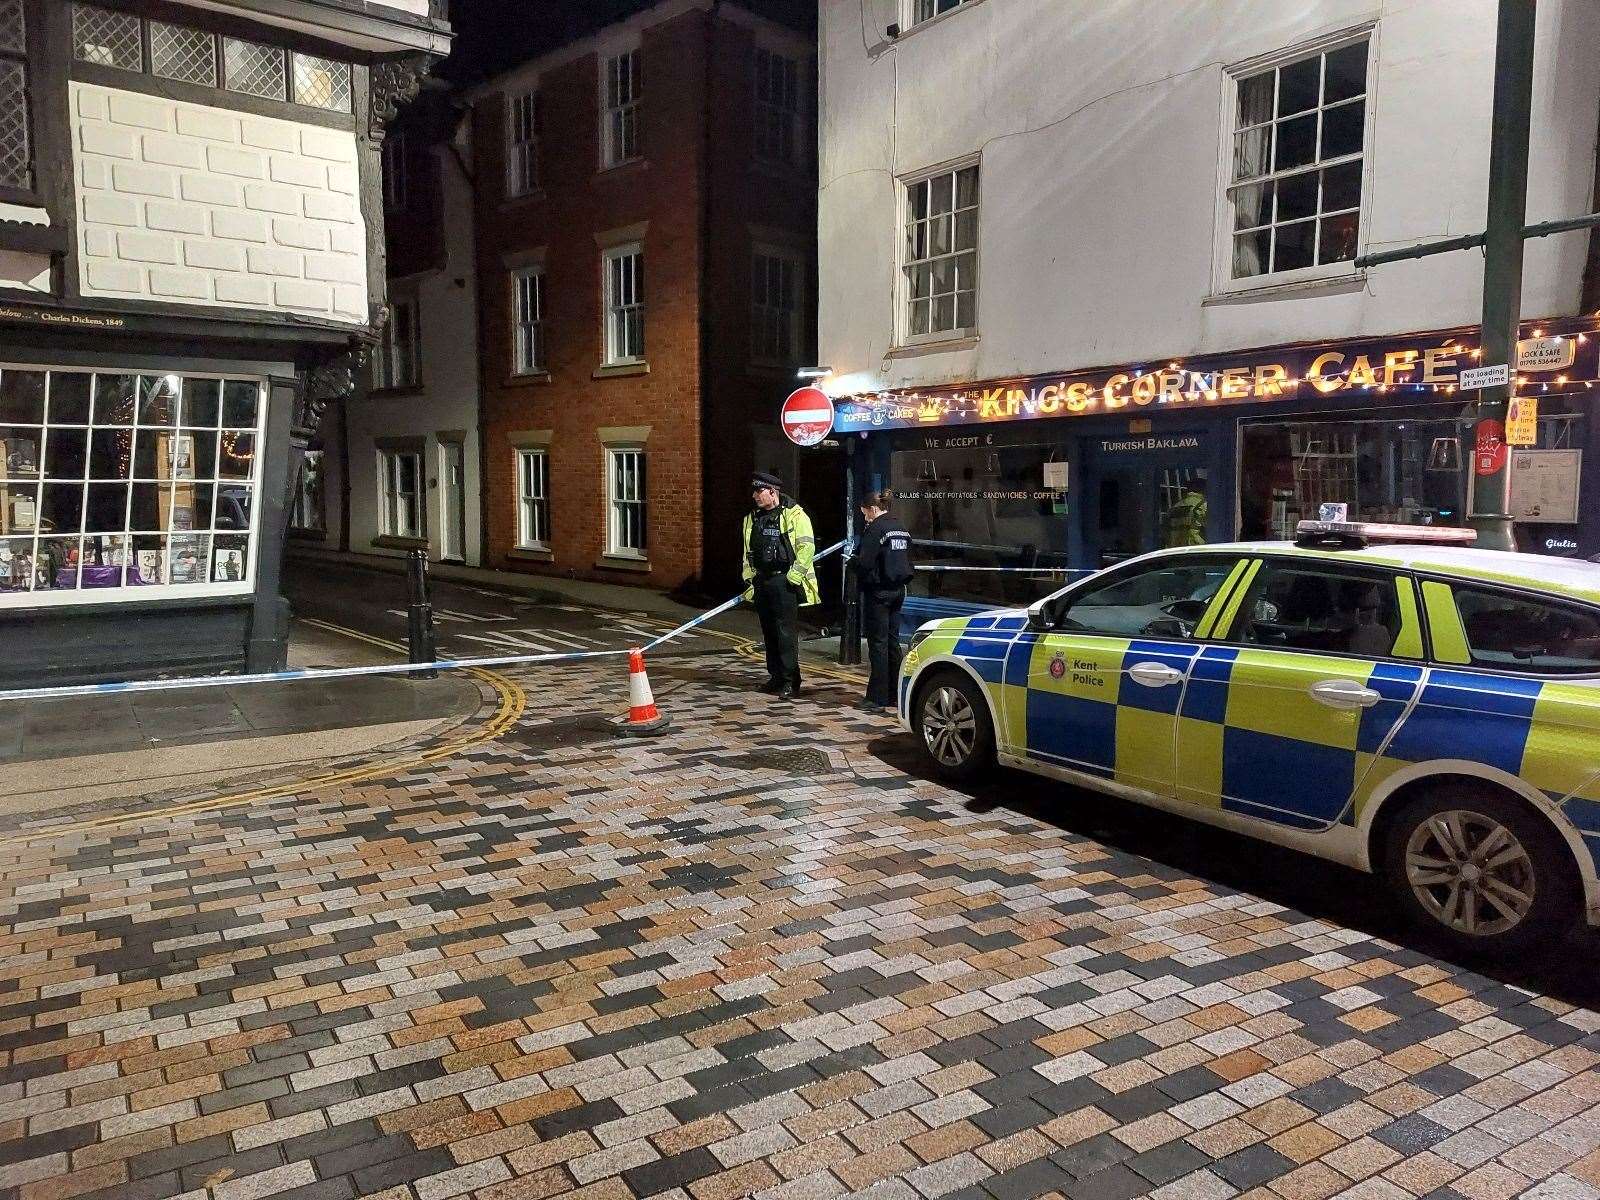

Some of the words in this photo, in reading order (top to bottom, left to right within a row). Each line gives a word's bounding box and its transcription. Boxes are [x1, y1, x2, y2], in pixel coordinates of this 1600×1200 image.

[41, 313, 70, 322] Charles
[72, 315, 104, 326] Dickens,
[1545, 349, 1560, 357] SAFE
[1520, 358, 1536, 366] 01795
[963, 390, 980, 400] THE
[980, 382, 1088, 418] KING'S
[1103, 364, 1286, 409] CORNER
[1309, 339, 1457, 393] CAFÉ
[1477, 368, 1505, 378] loading
[1488, 376, 1505, 384] time
[843, 412, 872, 423] COFFEE
[888, 408, 914, 420] CAKES
[925, 438, 939, 449] WE
[945, 436, 978, 447] ACCEPT
[1101, 440, 1145, 452] TURKISH
[1147, 438, 1199, 449] BAKLAVA
[899, 492, 920, 500] SALADS
[947, 491, 978, 499] POTATOES
[982, 491, 1027, 500] SANDWICHES
[1033, 491, 1060, 500] COFFEE
[1545, 539, 1577, 549] Giulia
[1073, 659, 1098, 671] Kent
[1072, 673, 1104, 687] Police
